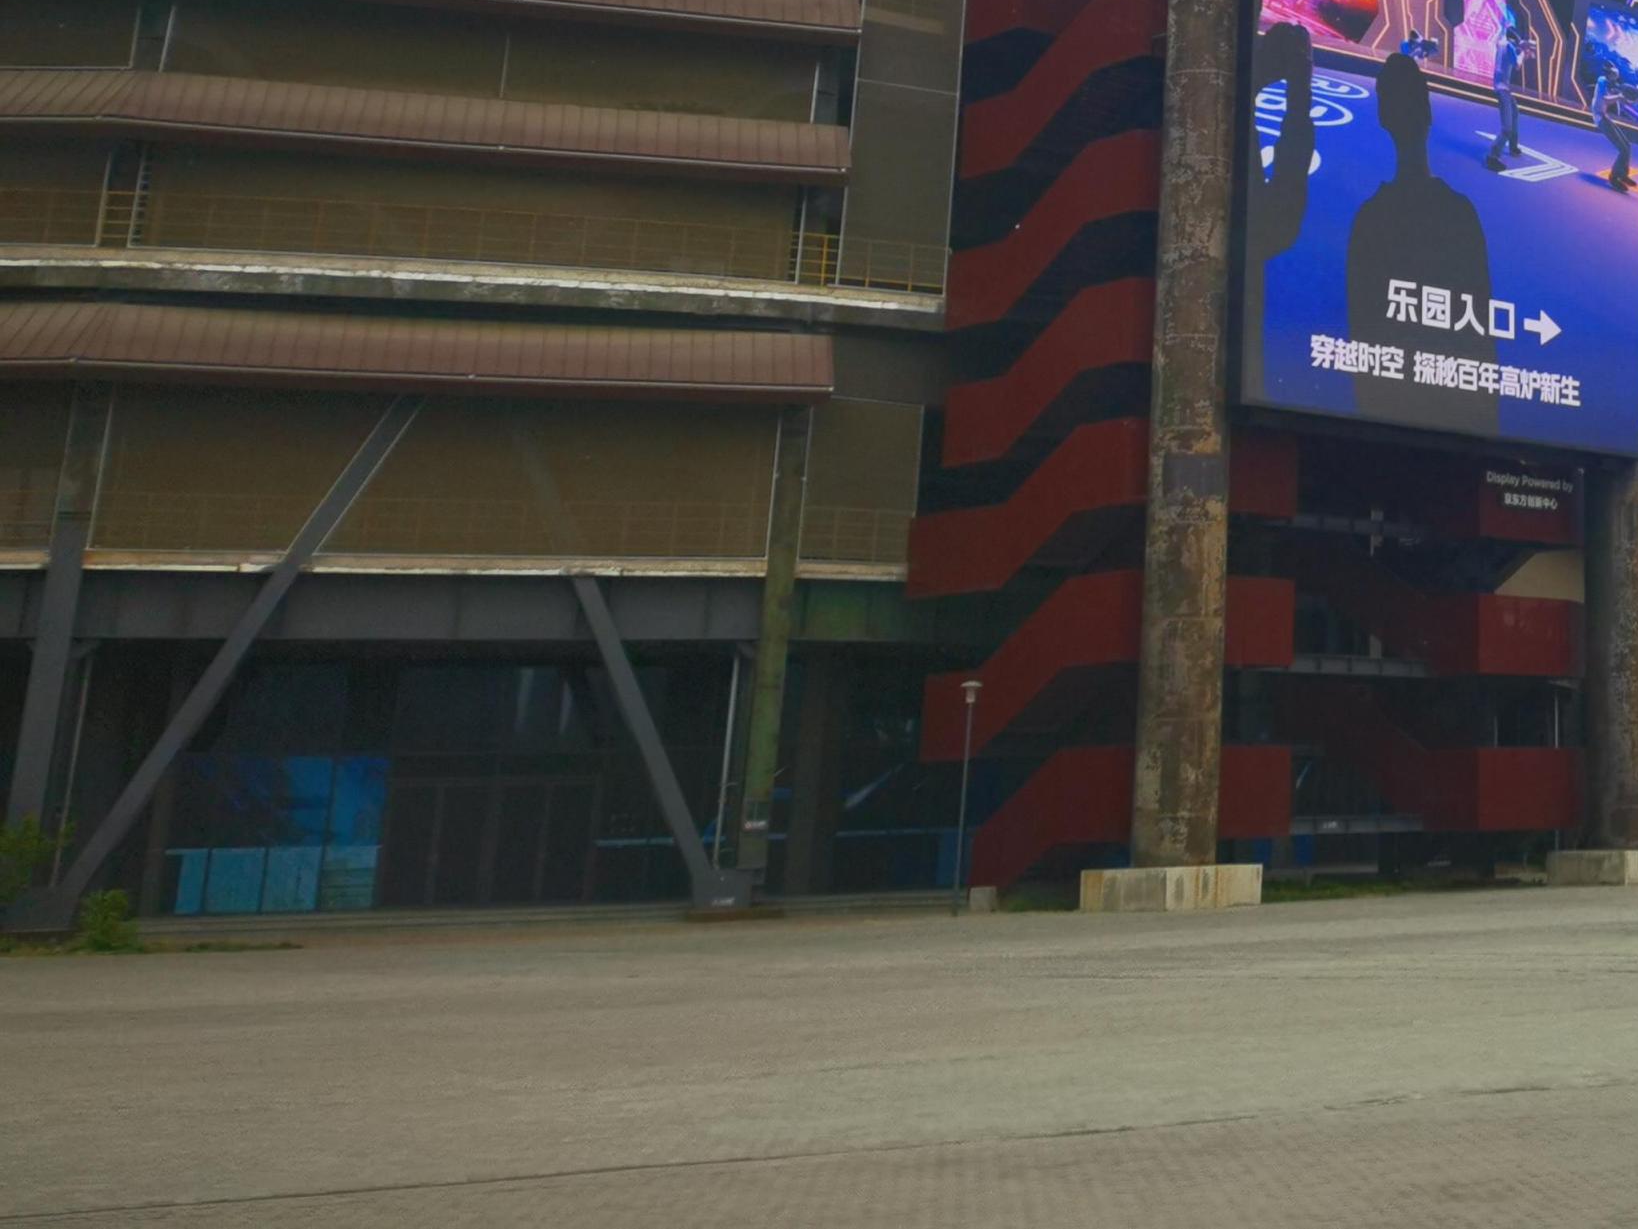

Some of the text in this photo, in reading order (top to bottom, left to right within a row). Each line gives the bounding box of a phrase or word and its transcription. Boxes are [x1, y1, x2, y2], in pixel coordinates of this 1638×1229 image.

[1386, 278, 1515, 340] 乐园入口
[1310, 334, 1581, 407] 穿越时空 探秘百年高炉新生
[1486, 470, 1574, 493] Display Powered by
